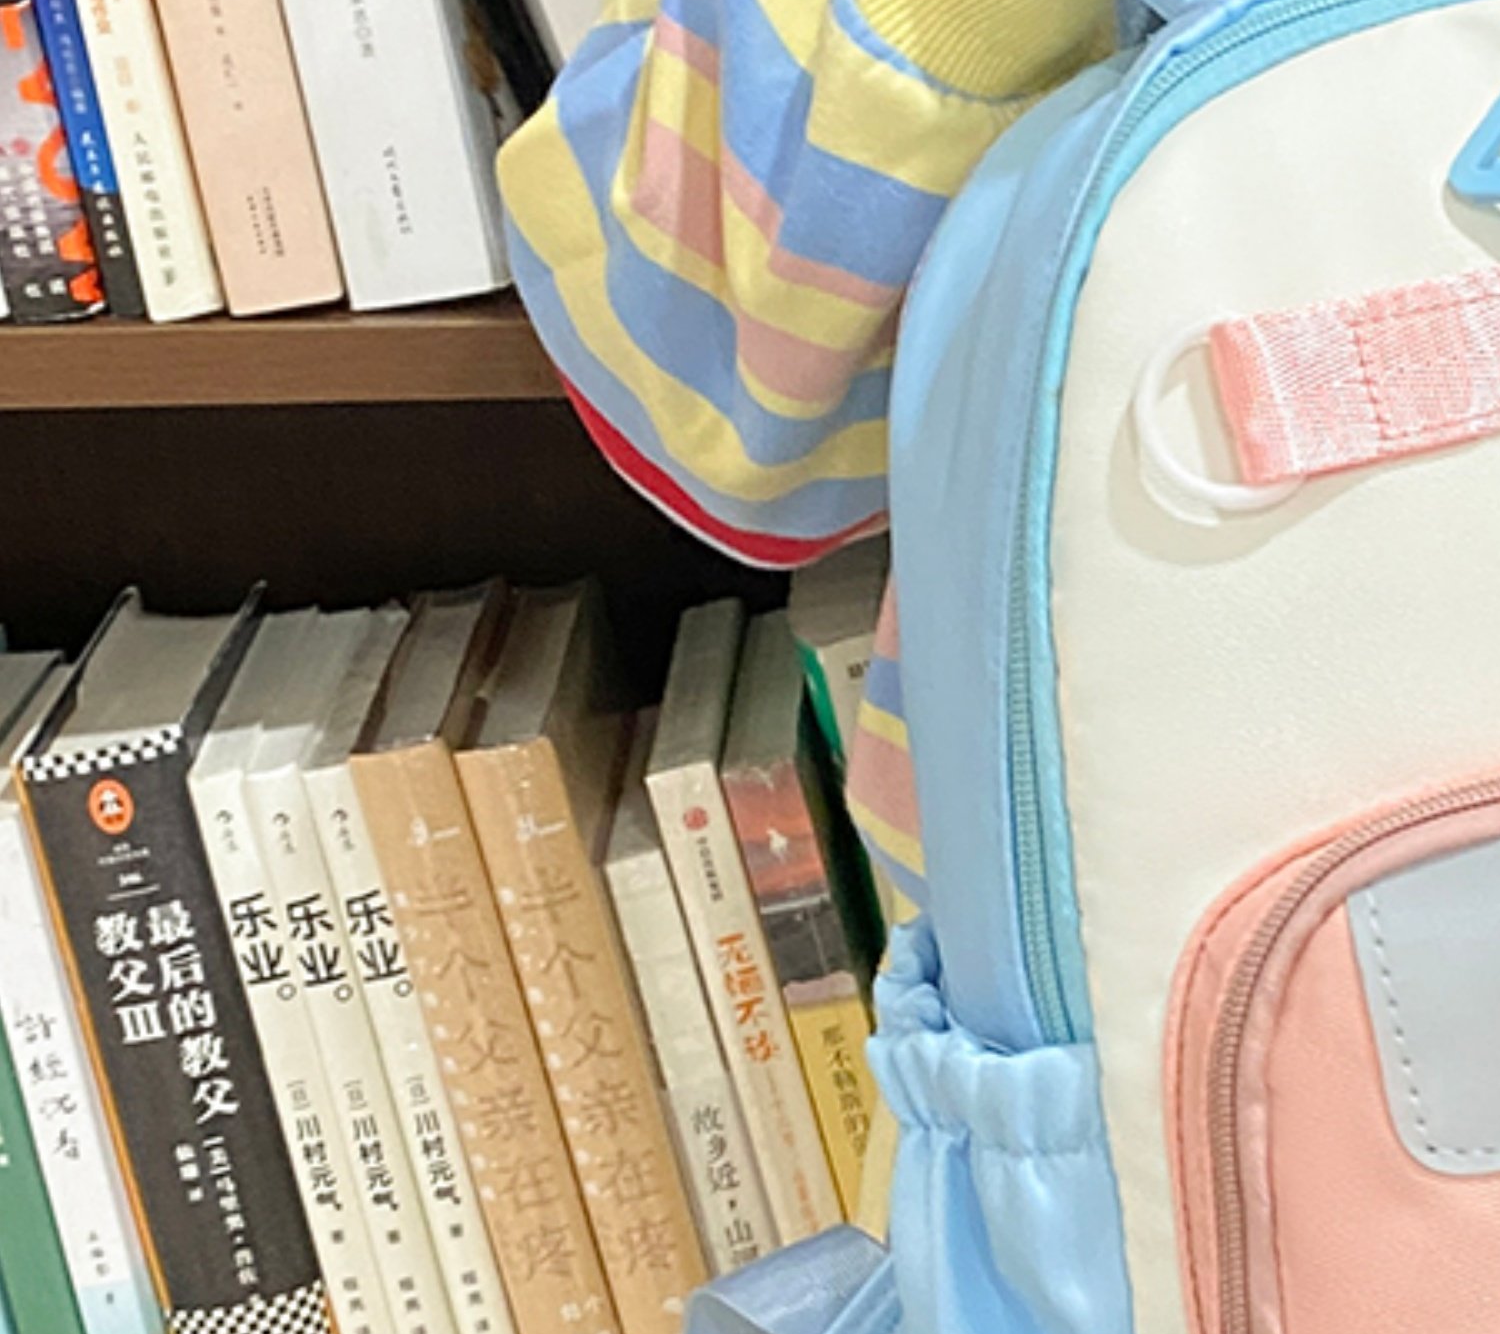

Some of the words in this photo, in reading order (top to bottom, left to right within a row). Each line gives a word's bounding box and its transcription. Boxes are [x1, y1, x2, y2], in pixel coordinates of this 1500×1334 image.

[146, 899, 241, 1125] 最后的教父
